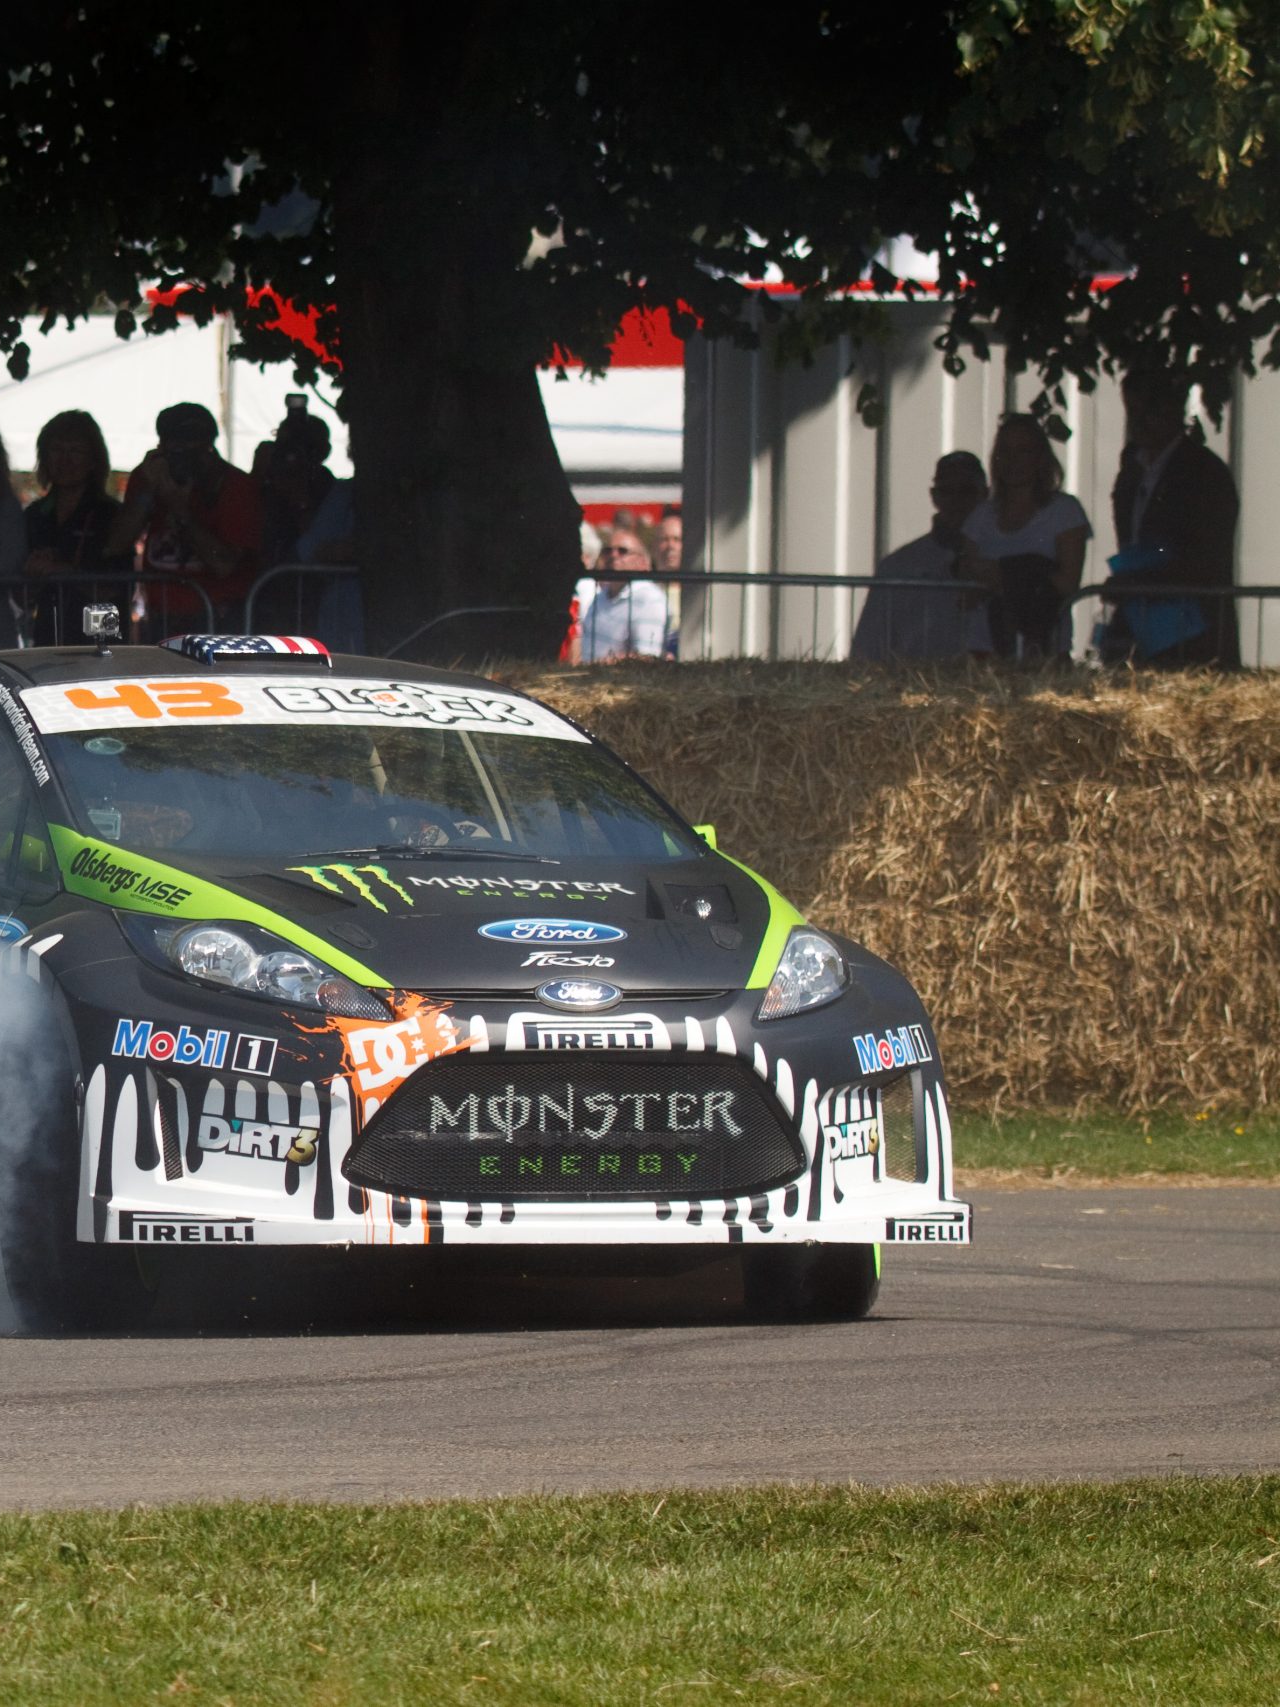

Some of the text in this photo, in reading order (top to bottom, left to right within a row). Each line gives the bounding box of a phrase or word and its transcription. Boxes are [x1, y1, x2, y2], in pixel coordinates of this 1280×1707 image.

[64, 682, 244, 719] 43
[70, 847, 193, 907] Olsbergs MSE
[407, 875, 636, 895] MONSTER
[456, 889, 609, 901] ENERGY
[511, 921, 598, 940] Ford
[520, 951, 615, 967] Fiesta
[557, 981, 603, 1002] Ford
[112, 1018, 231, 1069] Mobil
[522, 1020, 654, 1050] PIRELLI
[852, 1025, 917, 1075] Mobil
[347, 1016, 431, 1092] DC
[430, 1083, 743, 1143] MONSTER
[479, 1154, 698, 1175] ENERGY
[119, 1210, 256, 1242] PIRELLI
[885, 1211, 965, 1242] PIRELLI
